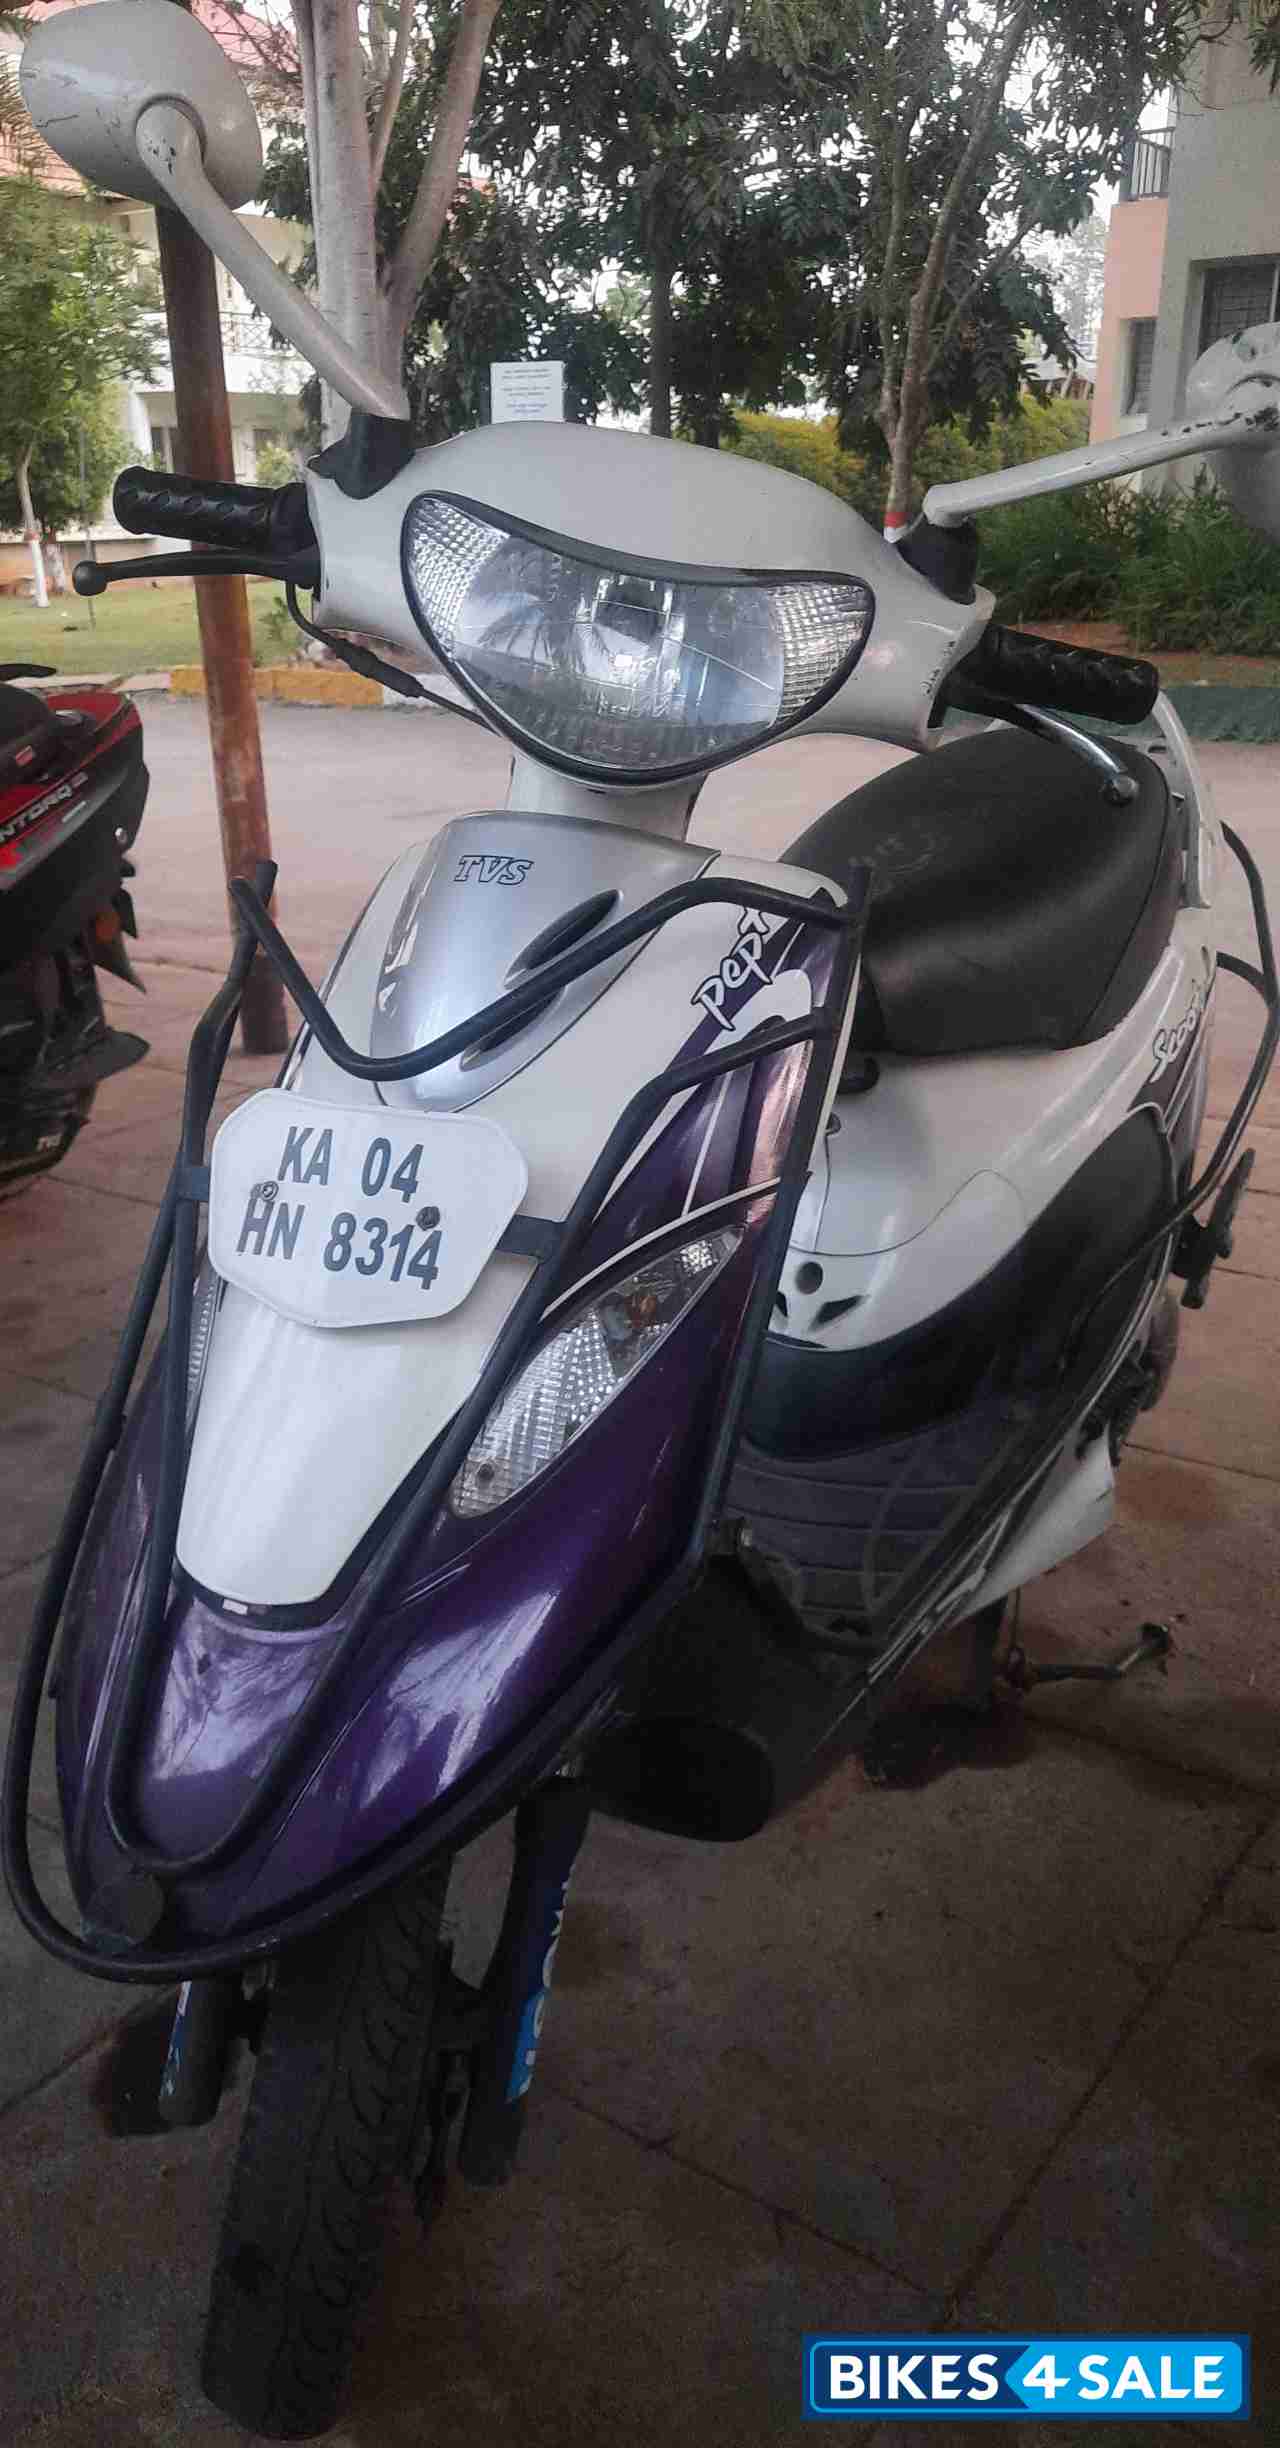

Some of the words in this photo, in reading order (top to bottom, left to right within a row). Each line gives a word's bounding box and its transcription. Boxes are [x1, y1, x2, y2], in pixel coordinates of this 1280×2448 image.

[453, 854, 534, 886] TVS
[277, 1125, 333, 1186] KA
[361, 1136, 425, 1203] 04
[236, 1183, 305, 1260] HN
[323, 1211, 443, 1291] 8314
